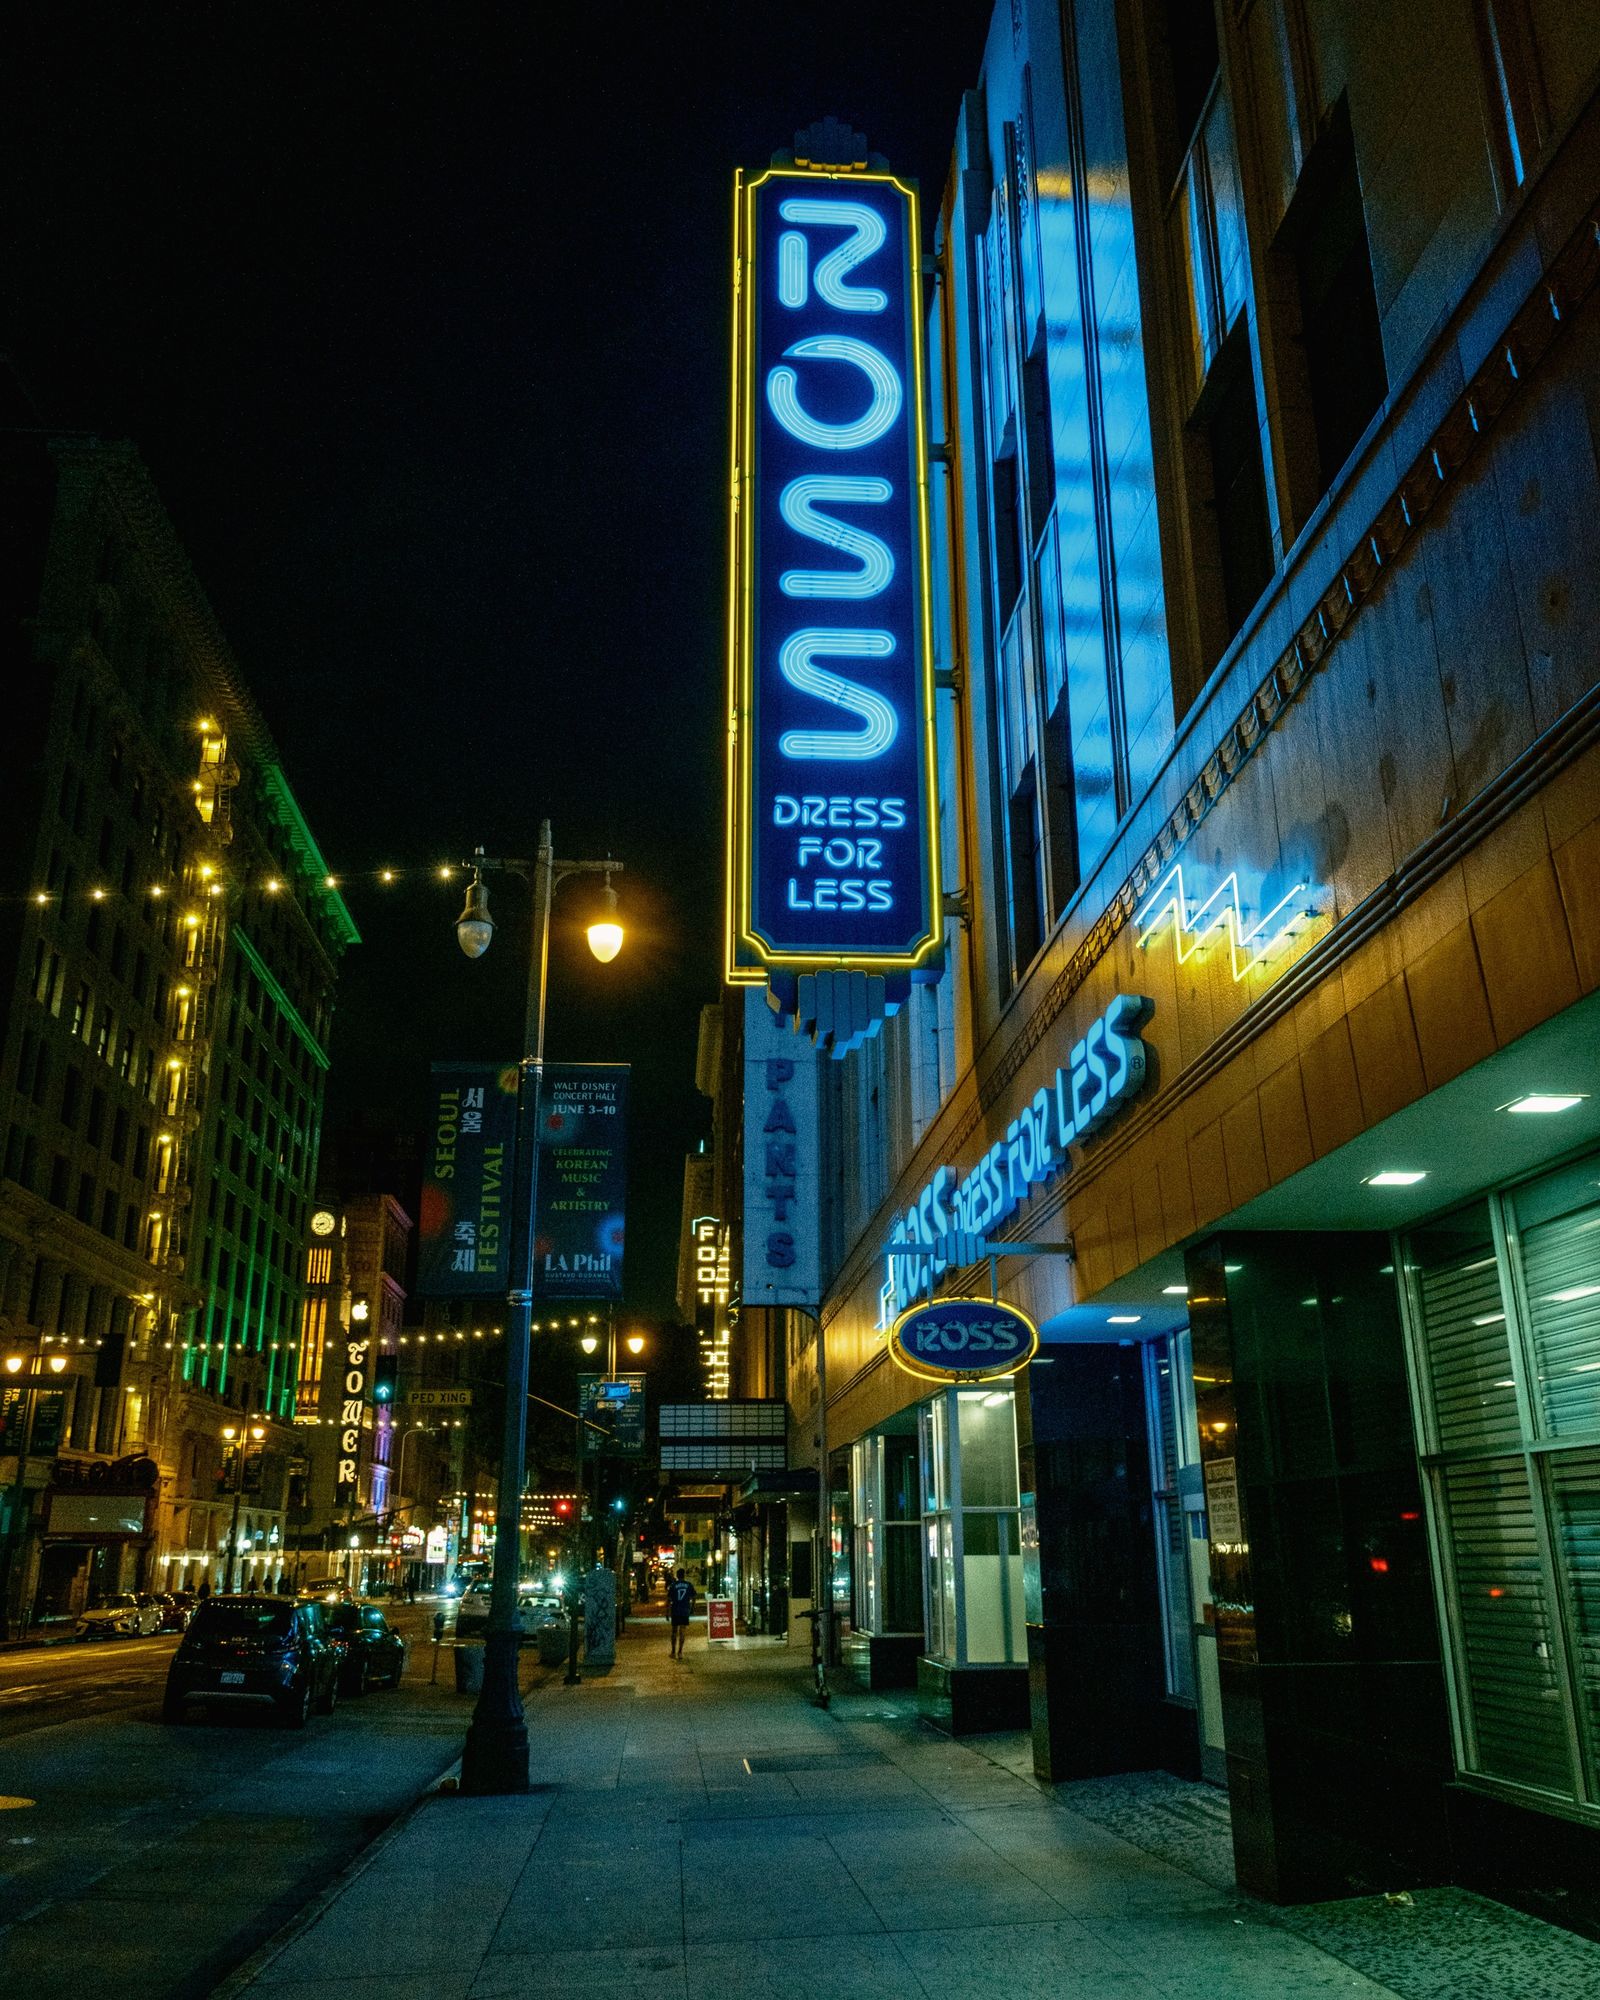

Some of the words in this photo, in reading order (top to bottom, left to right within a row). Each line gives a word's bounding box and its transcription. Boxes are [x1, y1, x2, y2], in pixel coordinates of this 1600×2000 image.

[766, 198, 903, 761] ROSS
[774, 795, 906, 827] DRESS
[798, 837, 882, 869] FOR
[788, 878, 893, 911] LESS
[553, 1082, 579, 1091] WALT
[581, 1082, 617, 1091] DISNEY
[553, 1091, 593, 1101] CONCERT
[595, 1092, 616, 1101] HALL
[1007, 1087, 1051, 1198] FOR
[1056, 994, 1129, 1149] LESS
[552, 1104, 585, 1115] JUNE
[434, 1087, 460, 1180] SEOUL
[556, 1160, 609, 1170] KOREAN
[561, 1173, 602, 1183] MUSIC
[763, 1058, 796, 1269] PANTS
[477, 1142, 504, 1273] FESTIVAL
[550, 1201, 610, 1211] ARTISTRY
[576, 1187, 585, 1197] &
[545, 1253, 569, 1271] LA
[573, 1253, 611, 1271] Phil
[697, 1225, 716, 1303] FOOT
[916, 1320, 1019, 1351] ROSS
[338, 1342, 367, 1483] TOWER
[411, 1393, 436, 1404] PED
[439, 1392, 467, 1404] XING
[677, 1589, 687, 1601] 17
